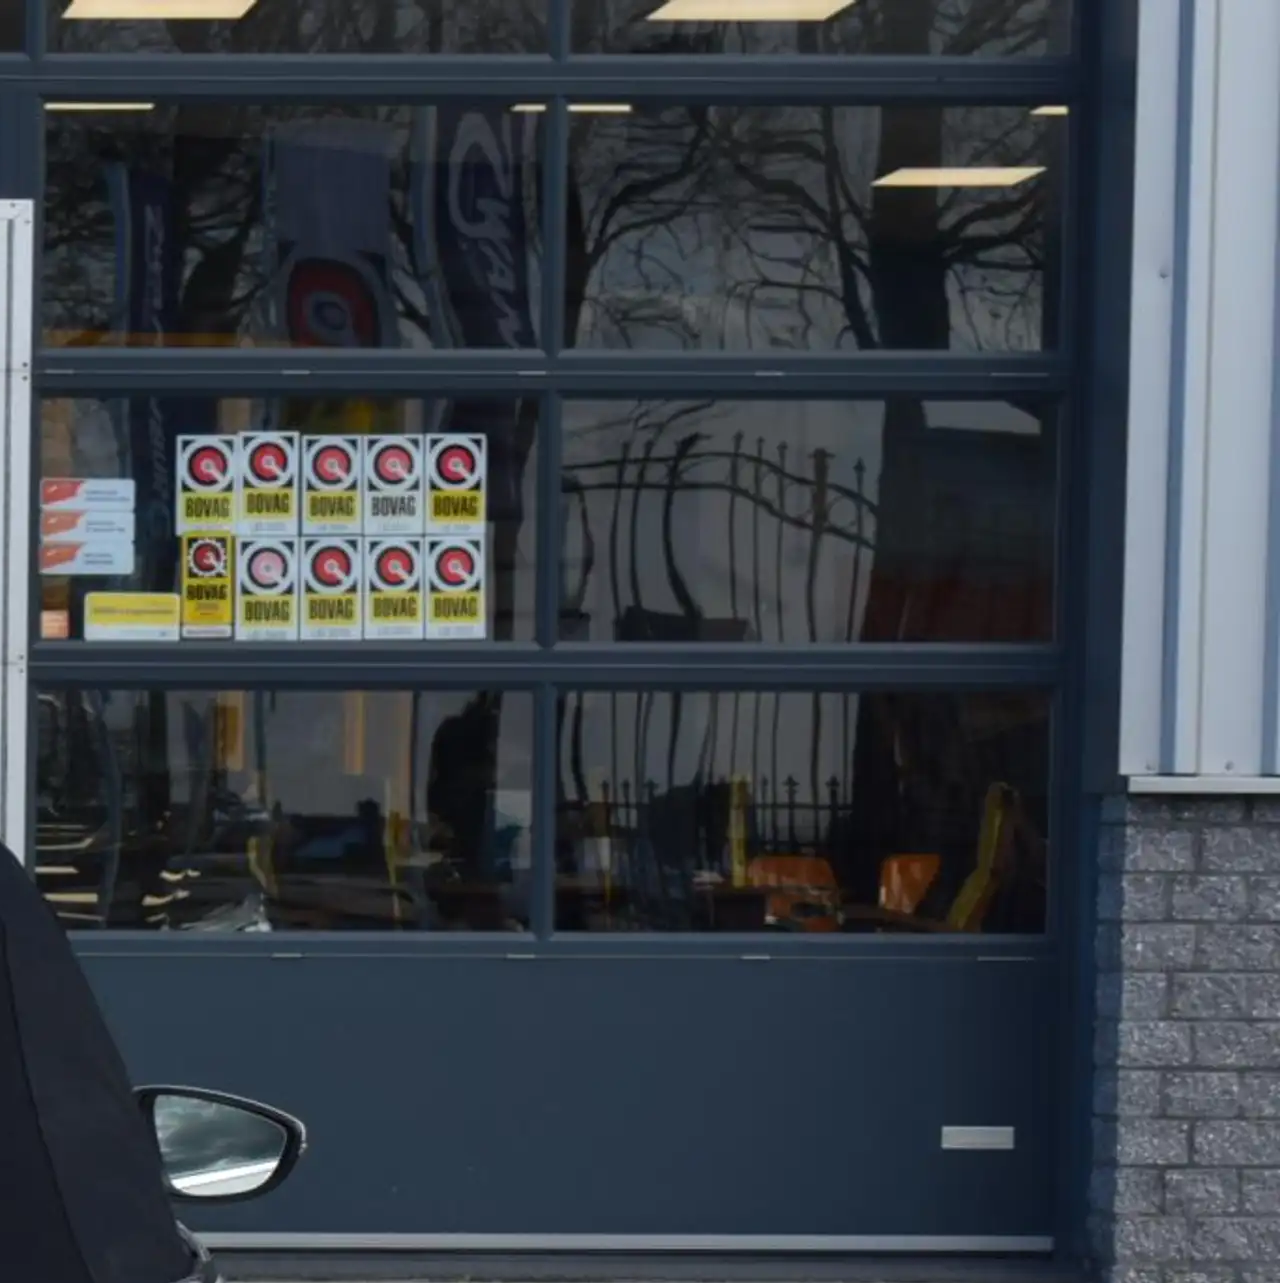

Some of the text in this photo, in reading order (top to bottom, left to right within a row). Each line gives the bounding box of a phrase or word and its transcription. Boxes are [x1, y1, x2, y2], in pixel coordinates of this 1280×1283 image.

[184, 496, 230, 518] BOVAG
[246, 492, 289, 514] BOVAG
[309, 495, 354, 517] BOVAG
[371, 495, 416, 517] BOVAG
[433, 495, 478, 517] BOVAG
[245, 600, 290, 622] BOVAG
[309, 598, 354, 620] BOVAG
[373, 596, 417, 618] BOVAG
[434, 597, 478, 619] BOVAG
